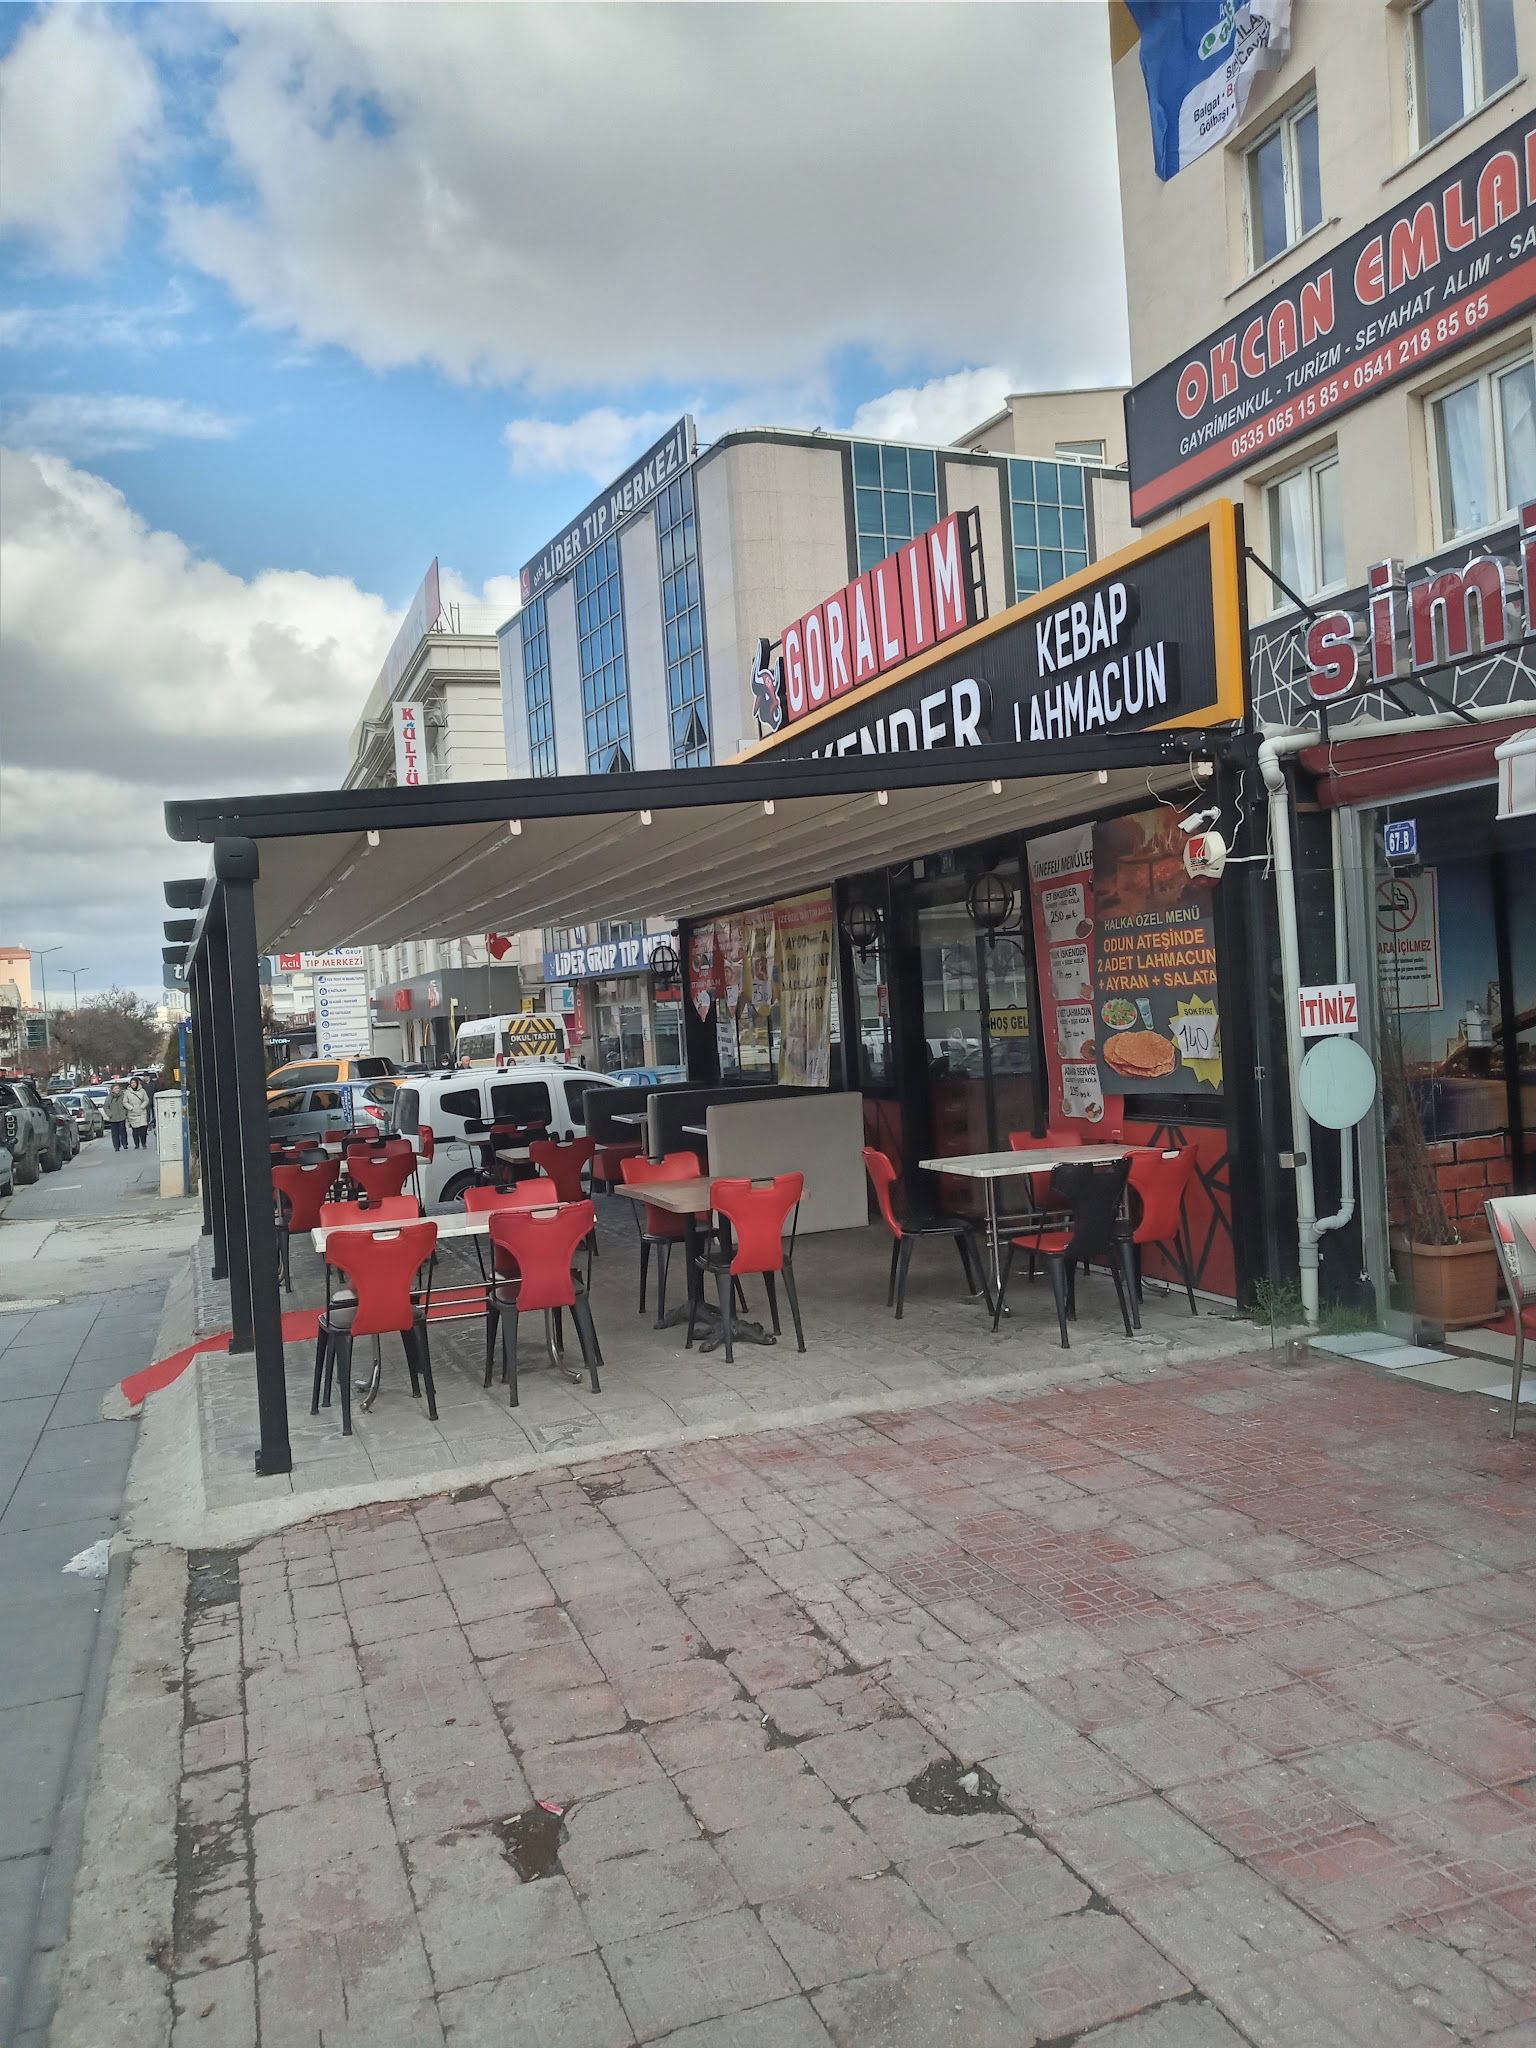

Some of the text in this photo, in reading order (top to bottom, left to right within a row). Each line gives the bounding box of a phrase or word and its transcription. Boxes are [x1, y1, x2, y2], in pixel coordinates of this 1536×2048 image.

[1194, 95, 1220, 122] Balgat
[1176, 269, 1336, 420] OKCAN
[1179, 388, 1274, 456] GAYRİMENKUL
[1285, 349, 1342, 393] TURİZM
[1356, 287, 1434, 354] SEYAHAT
[1443, 253, 1491, 300] ALIM
[1231, 295, 1489, 458] 0535 065 15 85 0541 218 85 65
[543, 527, 582, 581] LİDER
[582, 504, 607, 545] TIP
[610, 425, 684, 524] MERKEZİ
[783, 522, 964, 714] GORALIM
[1035, 582, 1127, 677] KEBAP
[1104, 905, 1200, 931] HALKA ÖZEL MENÜ
[587, 944, 617, 973] GRUP
[619, 940, 640, 968] TIP
[1103, 928, 1205, 953] ODUN ATEŞİNDE
[1097, 949, 1216, 973] 2 ADET LAHMACUN
[1105, 974, 1149, 991] AYRAN
[1163, 970, 1217, 987] SALATA
[990, 1016, 1008, 1032] HOŞ
[1300, 991, 1357, 1027] İTİNİZ
[1179, 1024, 1209, 1055] 140
